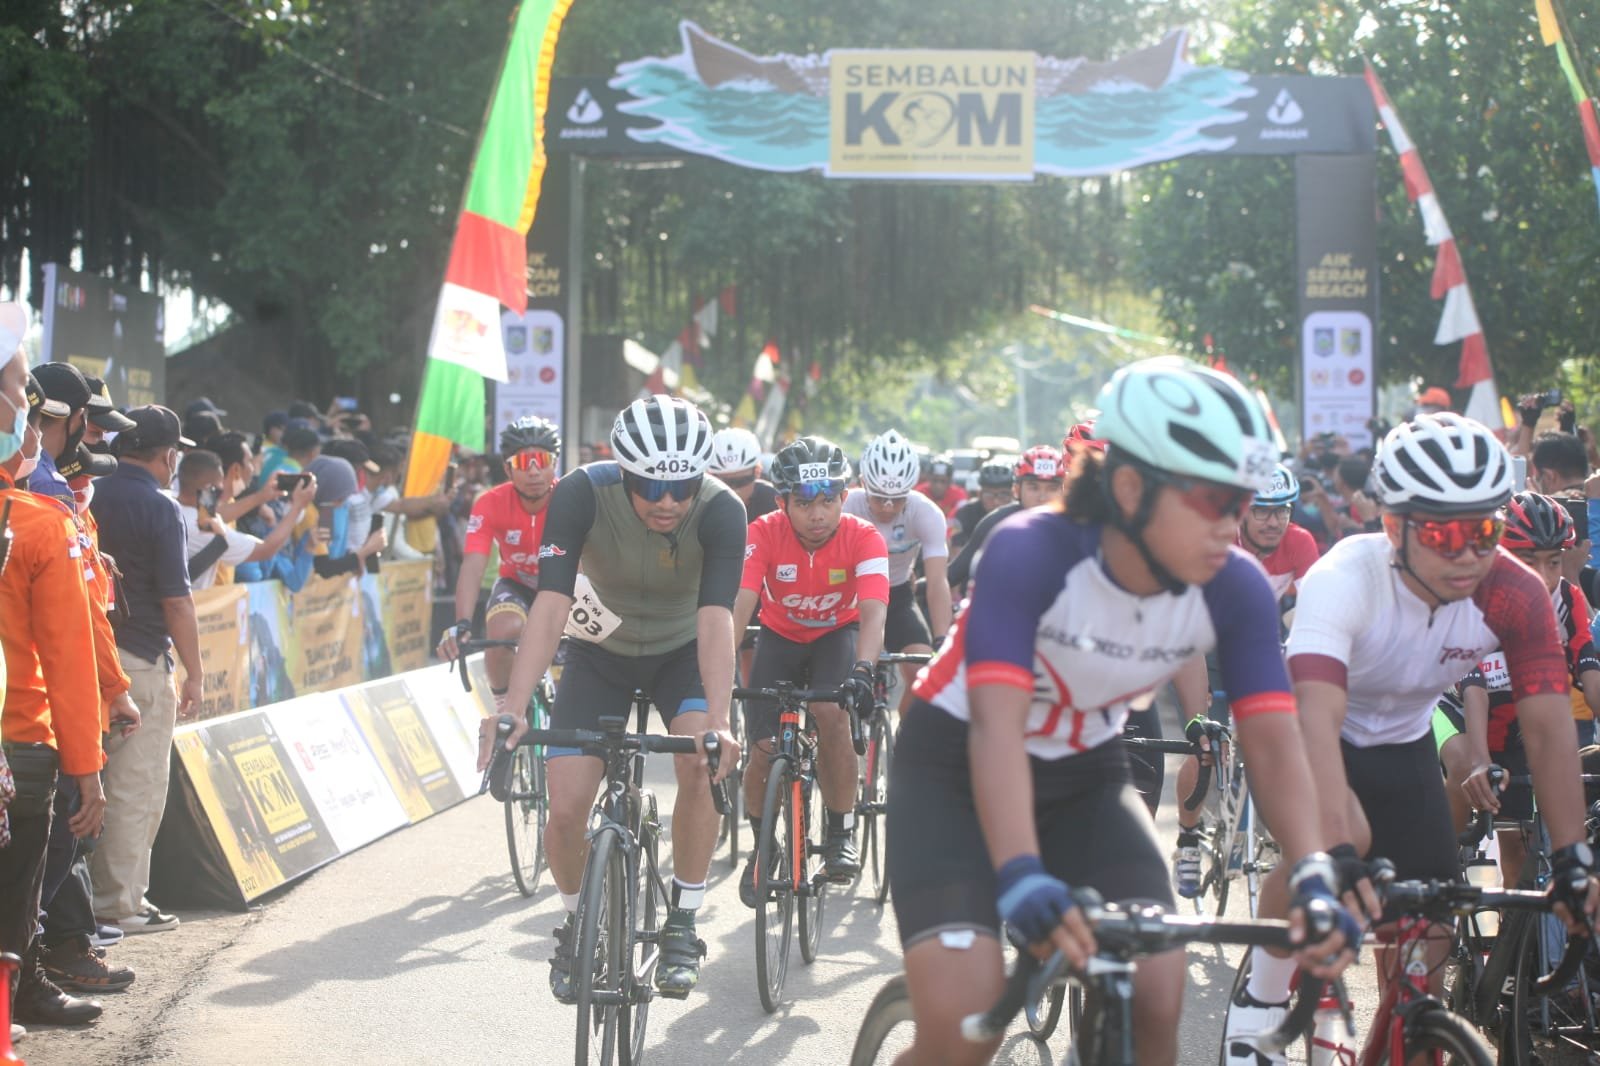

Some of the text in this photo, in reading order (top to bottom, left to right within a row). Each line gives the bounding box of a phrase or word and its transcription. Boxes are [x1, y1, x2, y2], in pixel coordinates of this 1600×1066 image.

[845, 65, 1026, 87] SEMBALUN
[845, 91, 1022, 148] KOM
[656, 460, 689, 473] 403
[802, 468, 827, 479] 209
[882, 480, 902, 489] 204
[782, 592, 842, 611] GKD
[570, 607, 603, 636] 03
[249, 770, 297, 815] KOM
